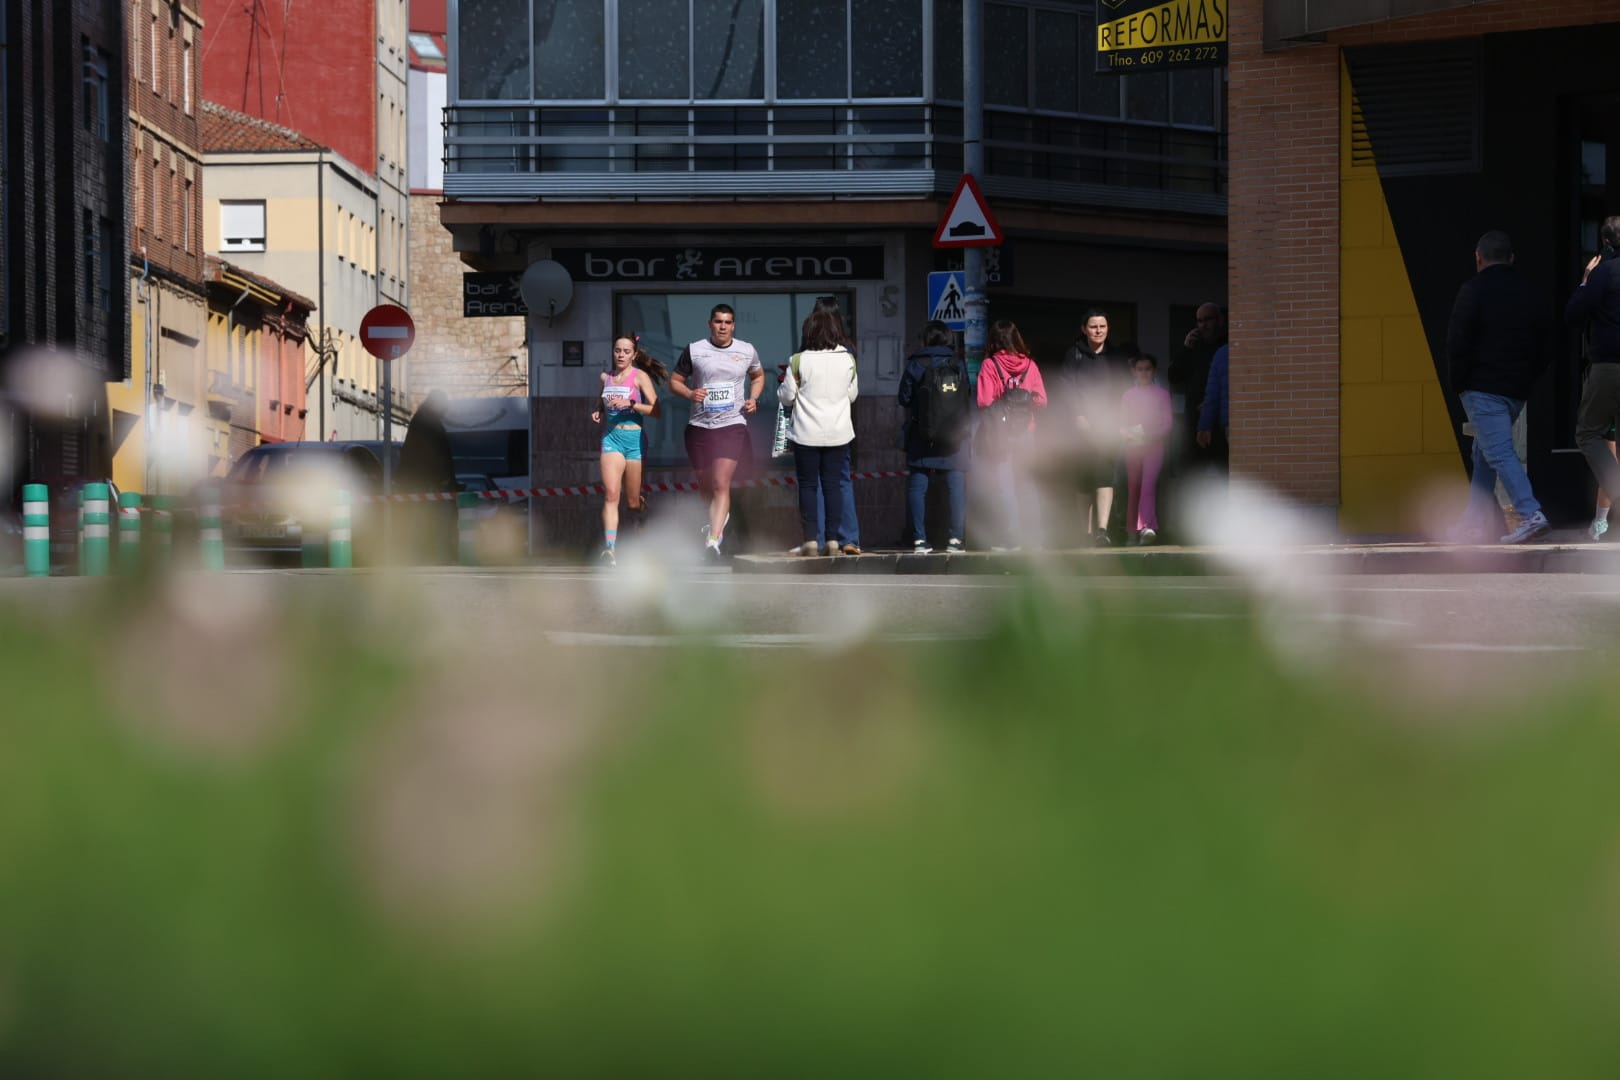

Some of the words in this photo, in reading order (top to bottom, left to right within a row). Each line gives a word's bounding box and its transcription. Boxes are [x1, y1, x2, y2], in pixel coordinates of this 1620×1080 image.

[1101, 0, 1225, 48] REFORMAS
[1108, 53, 1136, 66] Tfno.
[1140, 51, 1163, 64] 609
[1169, 48, 1191, 62] 262
[1195, 46, 1218, 60] 272
[585, 252, 664, 278] bar
[466, 282, 502, 295] bar
[708, 390, 730, 401] 3632
